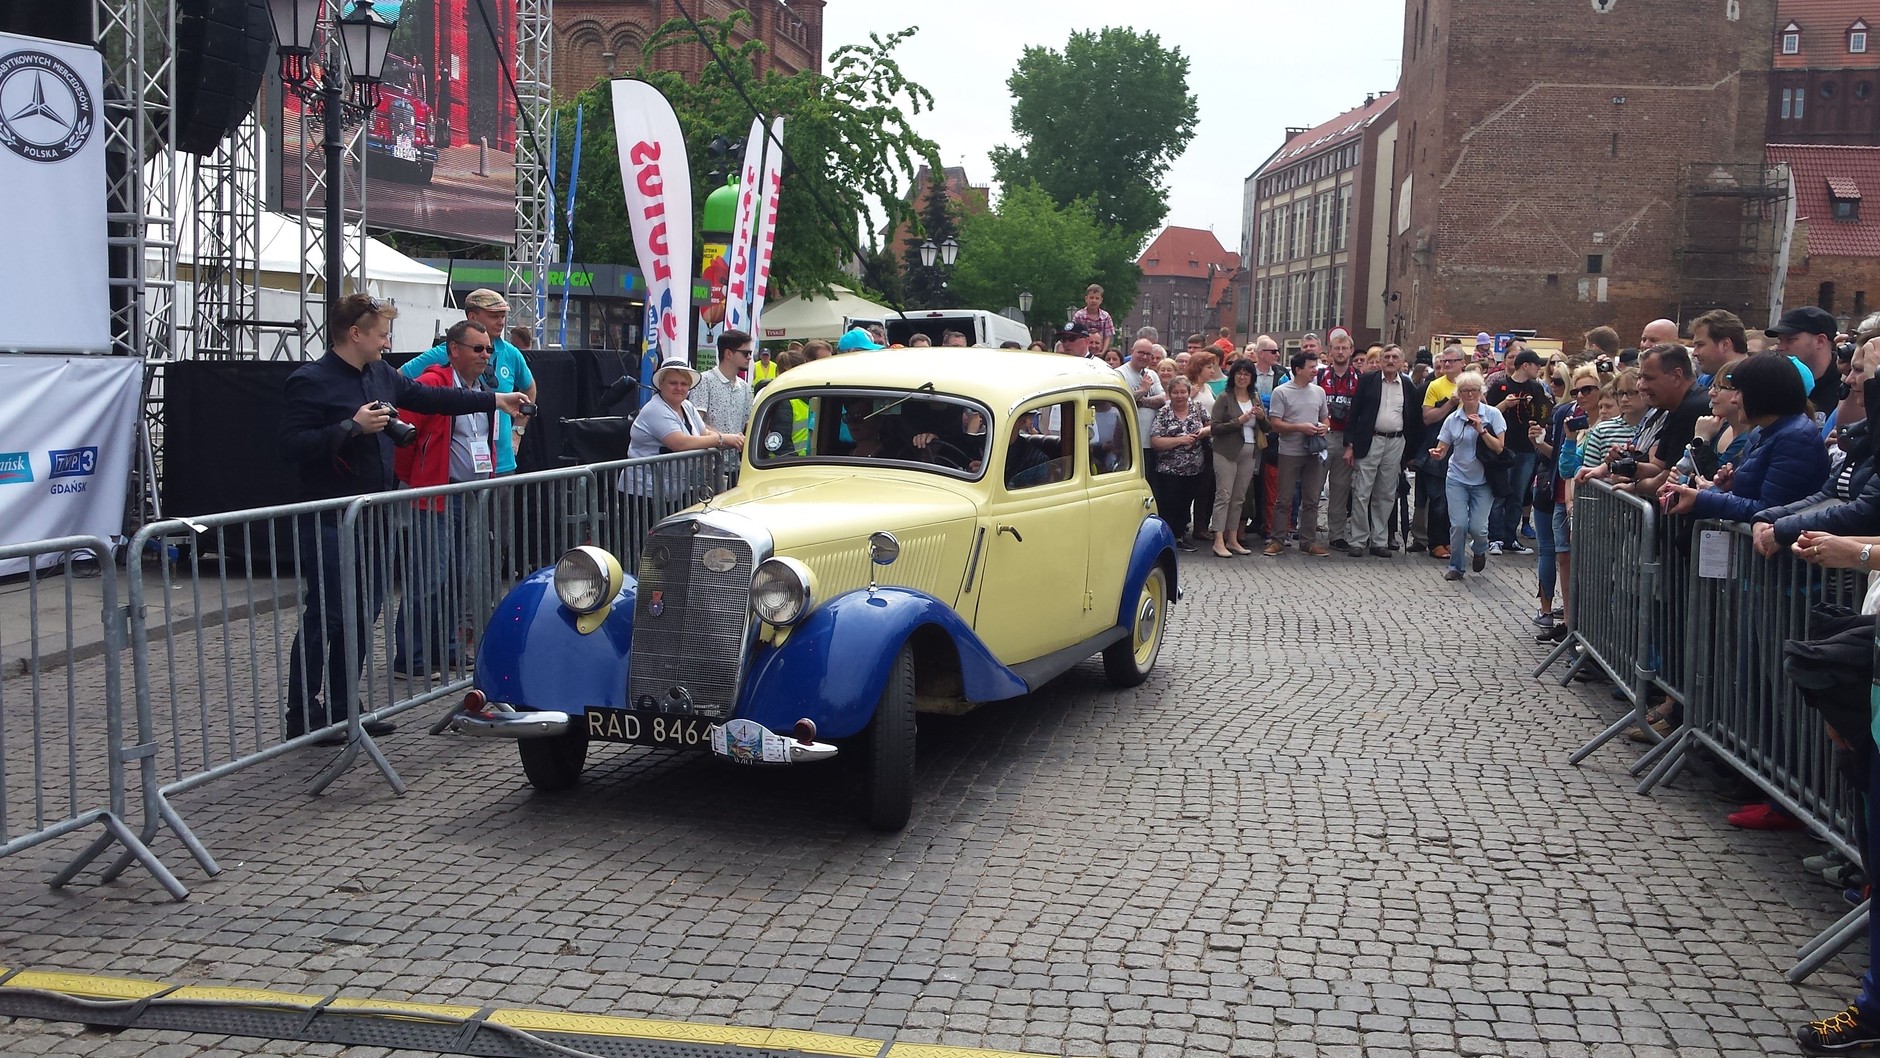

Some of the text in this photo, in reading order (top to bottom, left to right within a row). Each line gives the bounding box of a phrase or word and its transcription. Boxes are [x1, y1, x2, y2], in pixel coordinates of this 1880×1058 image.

[53, 62, 89, 111] MERCEDESÓW
[24, 145, 59, 158] POLSKA
[549, 271, 594, 287] RUCH
[58, 450, 94, 471] TVP 3
[50, 480, 88, 494] GDAŃSK
[588, 711, 641, 740] RAD
[653, 717, 713, 745] 8464
